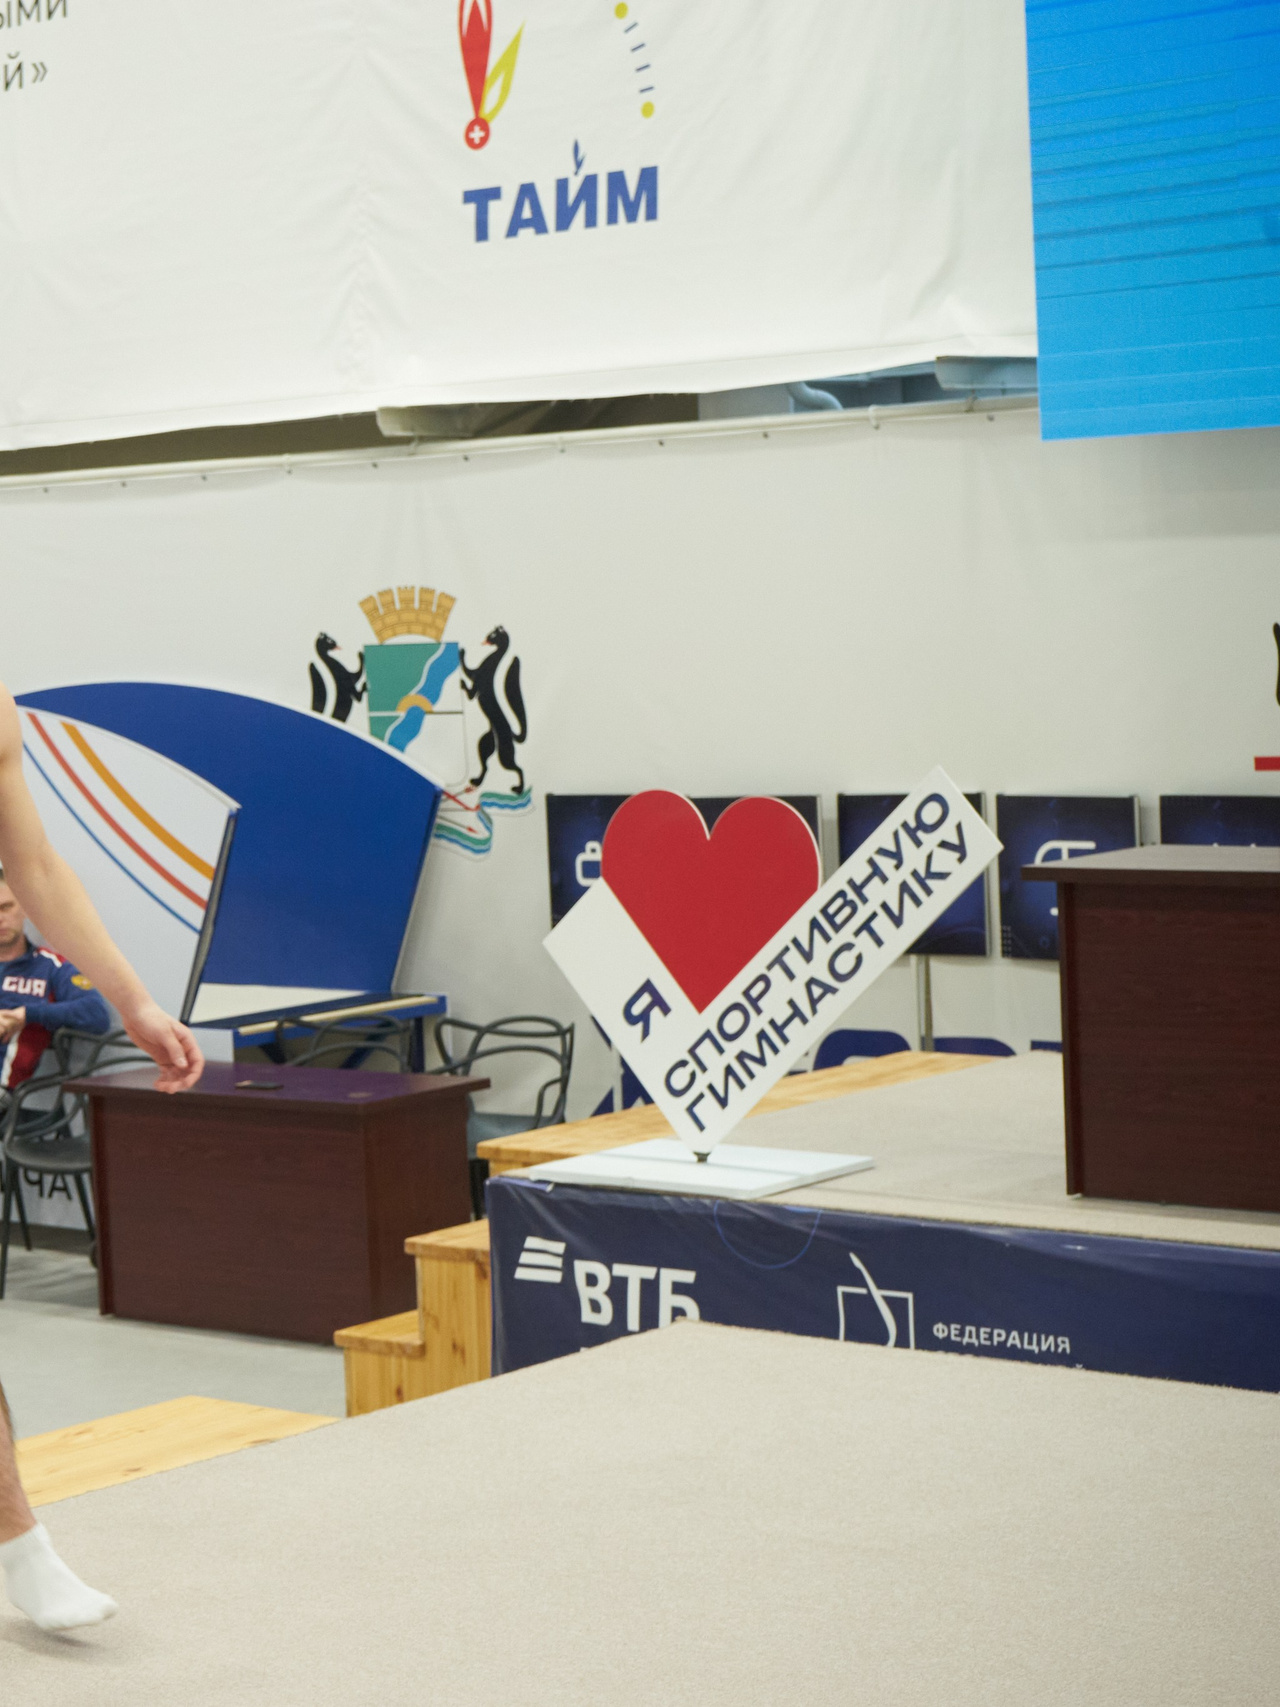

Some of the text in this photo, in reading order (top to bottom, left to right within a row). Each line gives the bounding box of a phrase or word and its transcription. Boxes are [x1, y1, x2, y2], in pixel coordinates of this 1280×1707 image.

[463, 139, 658, 243] ТАЙМ
[664, 792, 950, 1098] СПОРТИВНУЮ
[684, 820, 968, 1133] ГИМНАСТИКУ
[622, 978, 672, 1044] Я
[573, 1259, 700, 1332] ВТБ
[932, 1321, 1071, 1355] ФЕДЕРАЦИЯ
